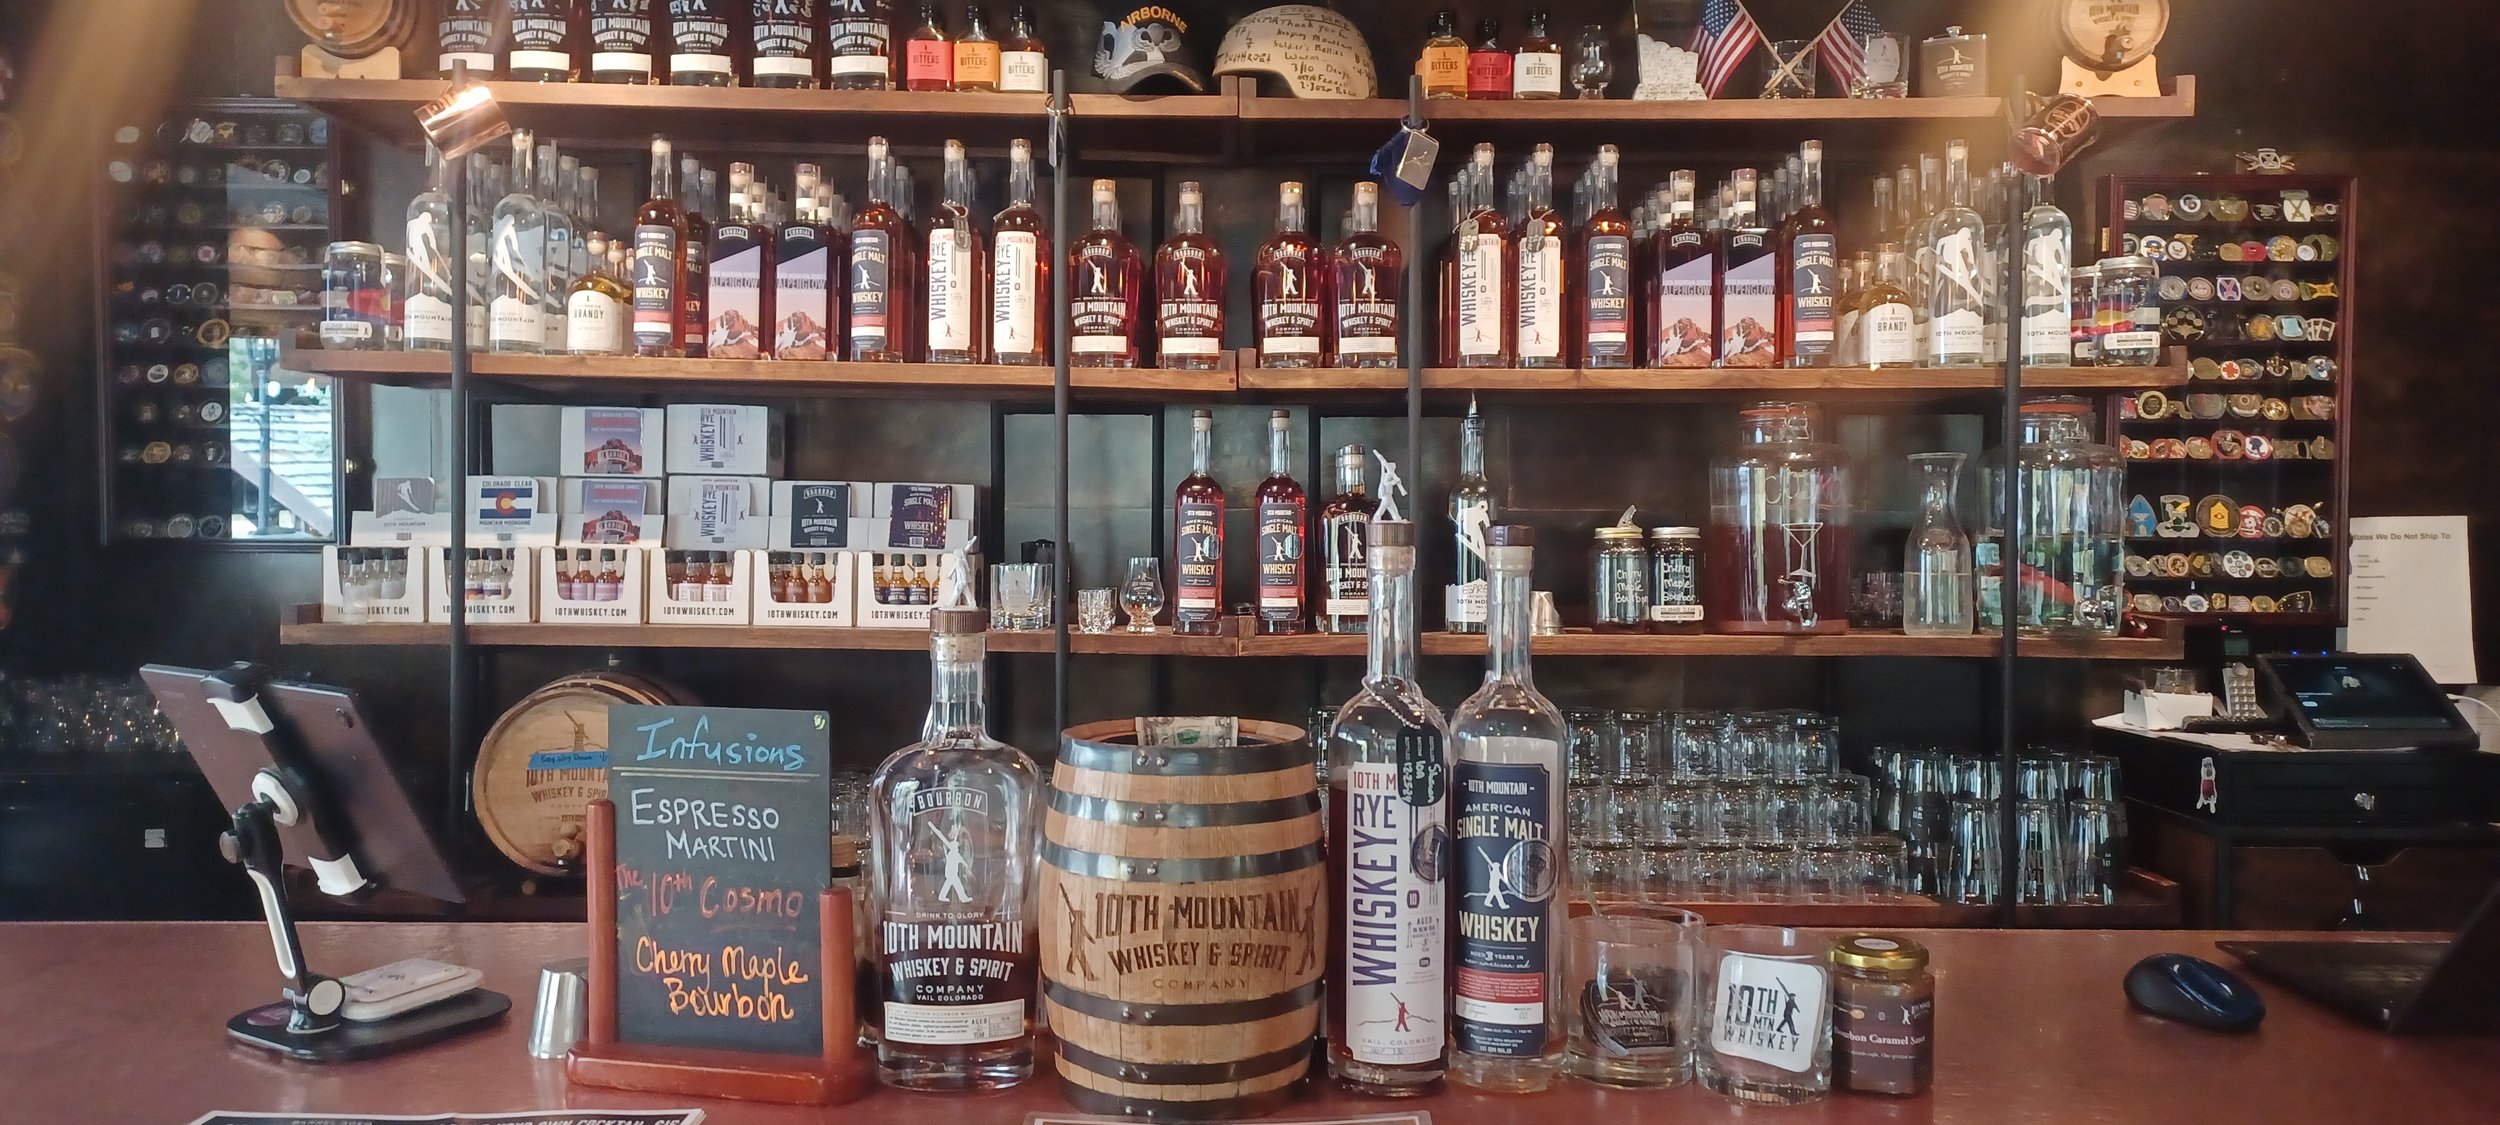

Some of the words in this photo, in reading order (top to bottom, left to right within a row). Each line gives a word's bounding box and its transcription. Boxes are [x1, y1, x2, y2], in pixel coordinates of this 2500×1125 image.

[1120, 6, 1188, 33] AIRBORNE
[913, 56, 940, 64] BITTERS
[960, 57, 987, 66] BITTERS
[1431, 61, 1458, 71] BITTERS
[1008, 65, 1035, 74] BITTERS
[1477, 66, 1503, 76] BITTERS
[1526, 66, 1553, 76] BITTERS
[655, 247, 672, 260] MALT
[868, 251, 886, 264] MALT
[1611, 257, 1627, 271] MALT
[1818, 256, 1834, 268] MALT
[710, 277, 760, 289] ALPENGLOW
[777, 278, 827, 290] ALPENGLOW
[931, 255, 946, 320] WHISKEY
[636, 288, 670, 300] WHISKEY
[996, 257, 1011, 323] WHISKEY
[1462, 261, 1477, 327] WHISKEY
[1521, 263, 1536, 329] WHISKEY
[1662, 285, 1712, 295] ALPENGLOW
[1726, 285, 1775, 295] ALPENGLOW
[852, 292, 883, 303] WHISKEY
[1591, 297, 1625, 309] WHISKEY
[1797, 297, 1832, 308] WHISKEY
[573, 309, 604, 320] BRANDY
[1087, 302, 1126, 317] MOUNTAIN
[1180, 303, 1218, 318] MOUNTAIN
[1280, 303, 1318, 318] MOUNTAIN
[1358, 303, 1395, 318] MOUNTAIN
[1877, 321, 1907, 332] BRANDY
[700, 414, 715, 423] RYE
[700, 422, 715, 462] WHISKEY
[703, 490, 717, 499] RYE
[701, 499, 717, 537] WHISKEY
[904, 520, 934, 533] WHISKEY
[1181, 525, 1201, 536] SINGLE
[1202, 525, 1217, 535] MALT
[1261, 524, 1282, 536] SINGLE
[1283, 524, 1298, 535] MALT
[2420, 533, 2438, 541] Ship
[1182, 564, 1215, 576] WHISKEY
[1263, 564, 1296, 575] WHISKEY
[1615, 592, 1648, 606] Bourbon
[554, 607, 627, 617] 10THWHISKEY.COM
[663, 607, 735, 617] 10THWHISKEY.COM
[767, 610, 839, 620] 10THWHISKEY.COM
[637, 716, 805, 770] Infusions
[1353, 771, 1380, 791] 10TH
[1468, 779, 1484, 793] 10TH
[1486, 780, 1528, 795] MOUNTAIN
[531, 786, 574, 803] WHISKEY
[587, 788, 608, 798] SPIR
[917, 791, 984, 811] BOURBON
[631, 788, 779, 830] ESPRESSO
[1353, 793, 1397, 829] RYE
[1465, 803, 1531, 817] AMERICAN
[1457, 815, 1500, 840] SINGLE
[1505, 816, 1544, 841] MALT
[666, 830, 775, 862] MARTINI
[652, 869, 692, 917] 10th
[701, 876, 803, 919] Cosmo
[1094, 892, 1160, 939] 10TH
[1173, 888, 1303, 934] MOUNTAIN
[1353, 828, 1397, 986] WHISKEY
[956, 911, 984, 919] GLORY
[1458, 910, 1540, 942] WHISKEY
[883, 920, 919, 955] 10TH
[927, 920, 1023, 954] MOUNTAIN
[1108, 941, 1200, 976] WHISKEY
[1209, 942, 1222, 967] &
[1230, 941, 1292, 973] SPIRIT
[637, 936, 711, 992] Cherry
[722, 946, 808, 998] Maple
[890, 957, 949, 982] WHISKEY
[956, 957, 964, 977] &
[970, 958, 1014, 982] SPIRIT
[916, 984, 984, 994] COMPANY
[1152, 978, 1249, 991] COMPANY
[664, 977, 794, 1022] Bourbon
[916, 993, 935, 1001] VAIL
[937, 993, 984, 1001] COLORADO
[1753, 1016, 1775, 1030] MTN
[1390, 1036, 1436, 1046] COLORADO
[1724, 1025, 1800, 1052] WHISKEY
[1869, 1034, 1908, 1045] Caramel
